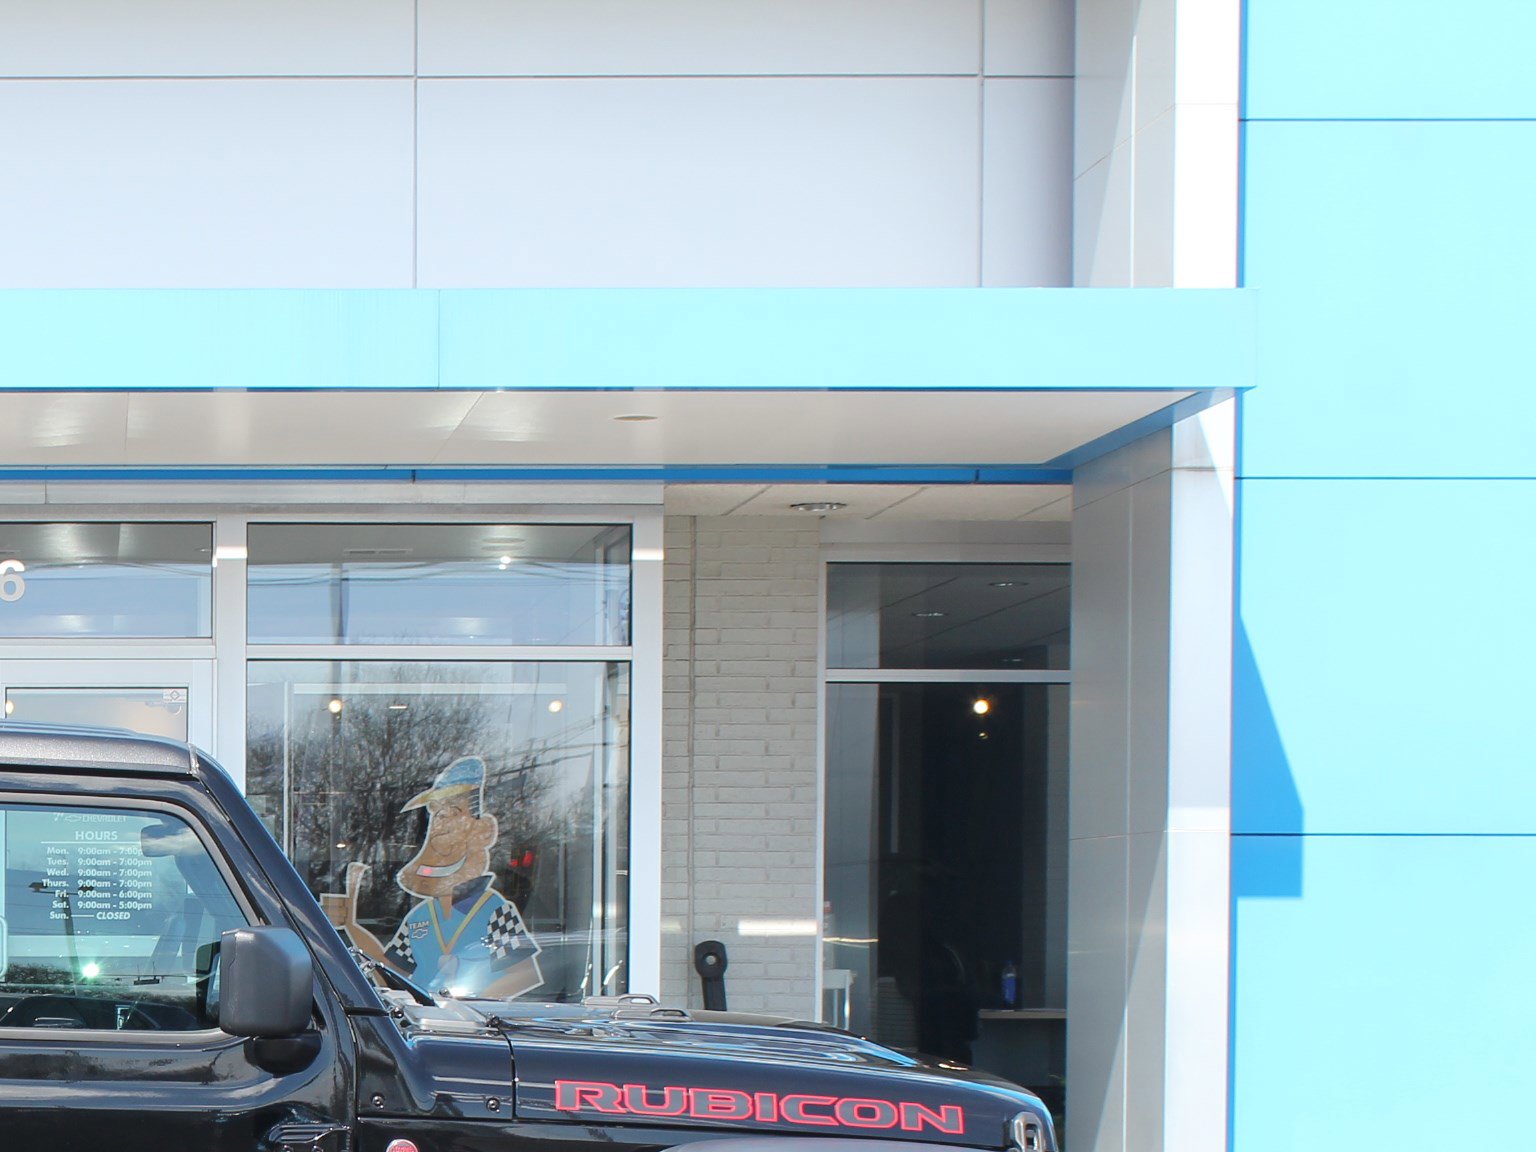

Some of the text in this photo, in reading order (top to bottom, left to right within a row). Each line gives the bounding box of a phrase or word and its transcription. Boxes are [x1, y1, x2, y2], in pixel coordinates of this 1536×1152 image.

[75, 831, 118, 841] HOURS
[47, 847, 69, 855] Mon.
[77, 847, 111, 855] 9:00am
[119, 847, 143, 857] 7:00p
[47, 858, 69, 866] Tues.
[77, 858, 111, 866] 9:00am
[119, 858, 153, 867] 7:00pm
[46, 868, 69, 876] Wed.
[77, 868, 111, 876] 9:00am
[119, 868, 153, 878] 7:00pm
[41, 879, 69, 887] Thurs.
[119, 879, 153, 889] 7:00pm
[55, 890, 69, 898] Fri.
[77, 890, 111, 898] 9:00am
[119, 890, 153, 900] 6:00pm
[52, 900, 69, 909] Sat.
[77, 900, 111, 909] 9:00am
[119, 900, 153, 911] 5:00pm
[49, 911, 131, 920] Sun. CLOSED
[409, 921, 429, 929] TEAM
[555, 1080, 964, 1134] RUBICON
